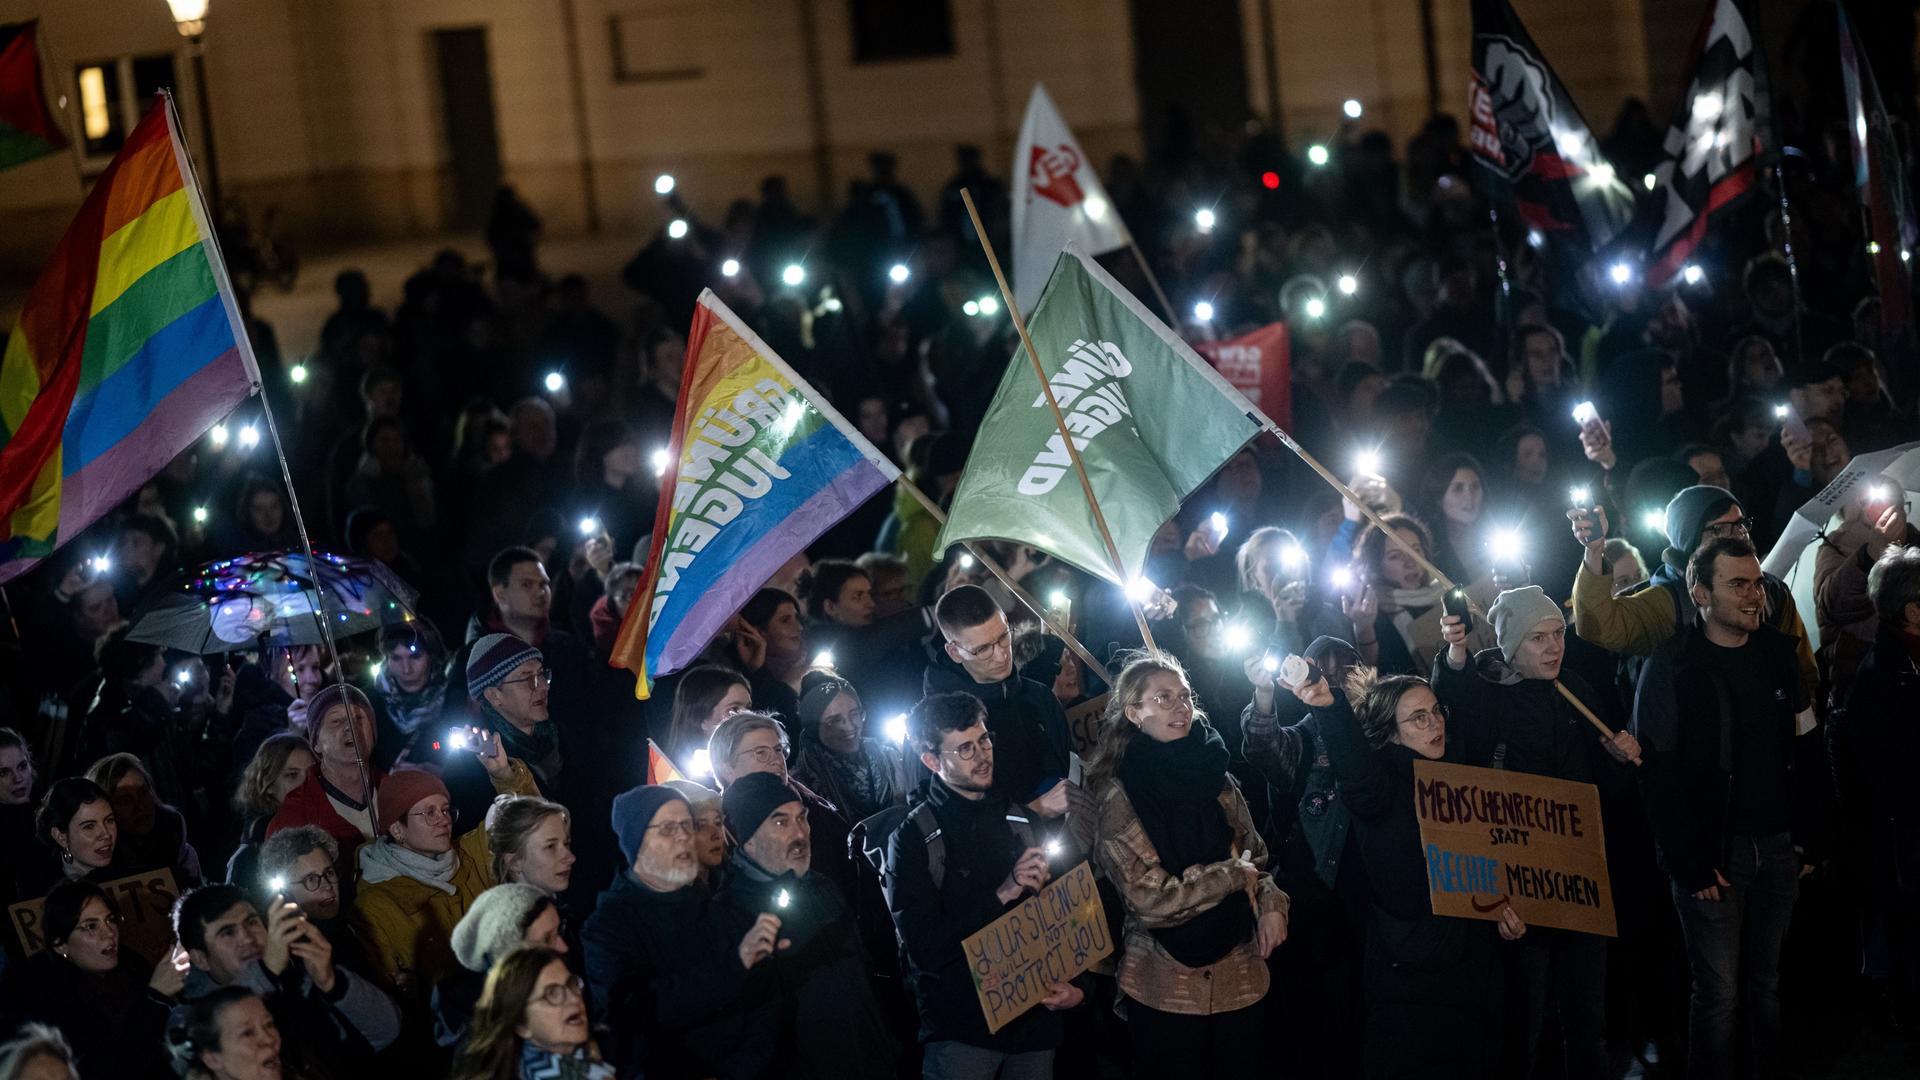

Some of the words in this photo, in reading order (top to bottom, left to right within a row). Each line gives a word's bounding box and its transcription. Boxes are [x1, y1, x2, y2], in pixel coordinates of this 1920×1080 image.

[1418, 778, 1583, 837] MENSCHENRECHTE
[1490, 828, 1529, 845] STATT
[1427, 843, 1499, 895] RECHTE
[1505, 863, 1600, 908] MENSCHEN
[15, 878, 174, 950] RTS
[1045, 921, 1068, 947] NOT
